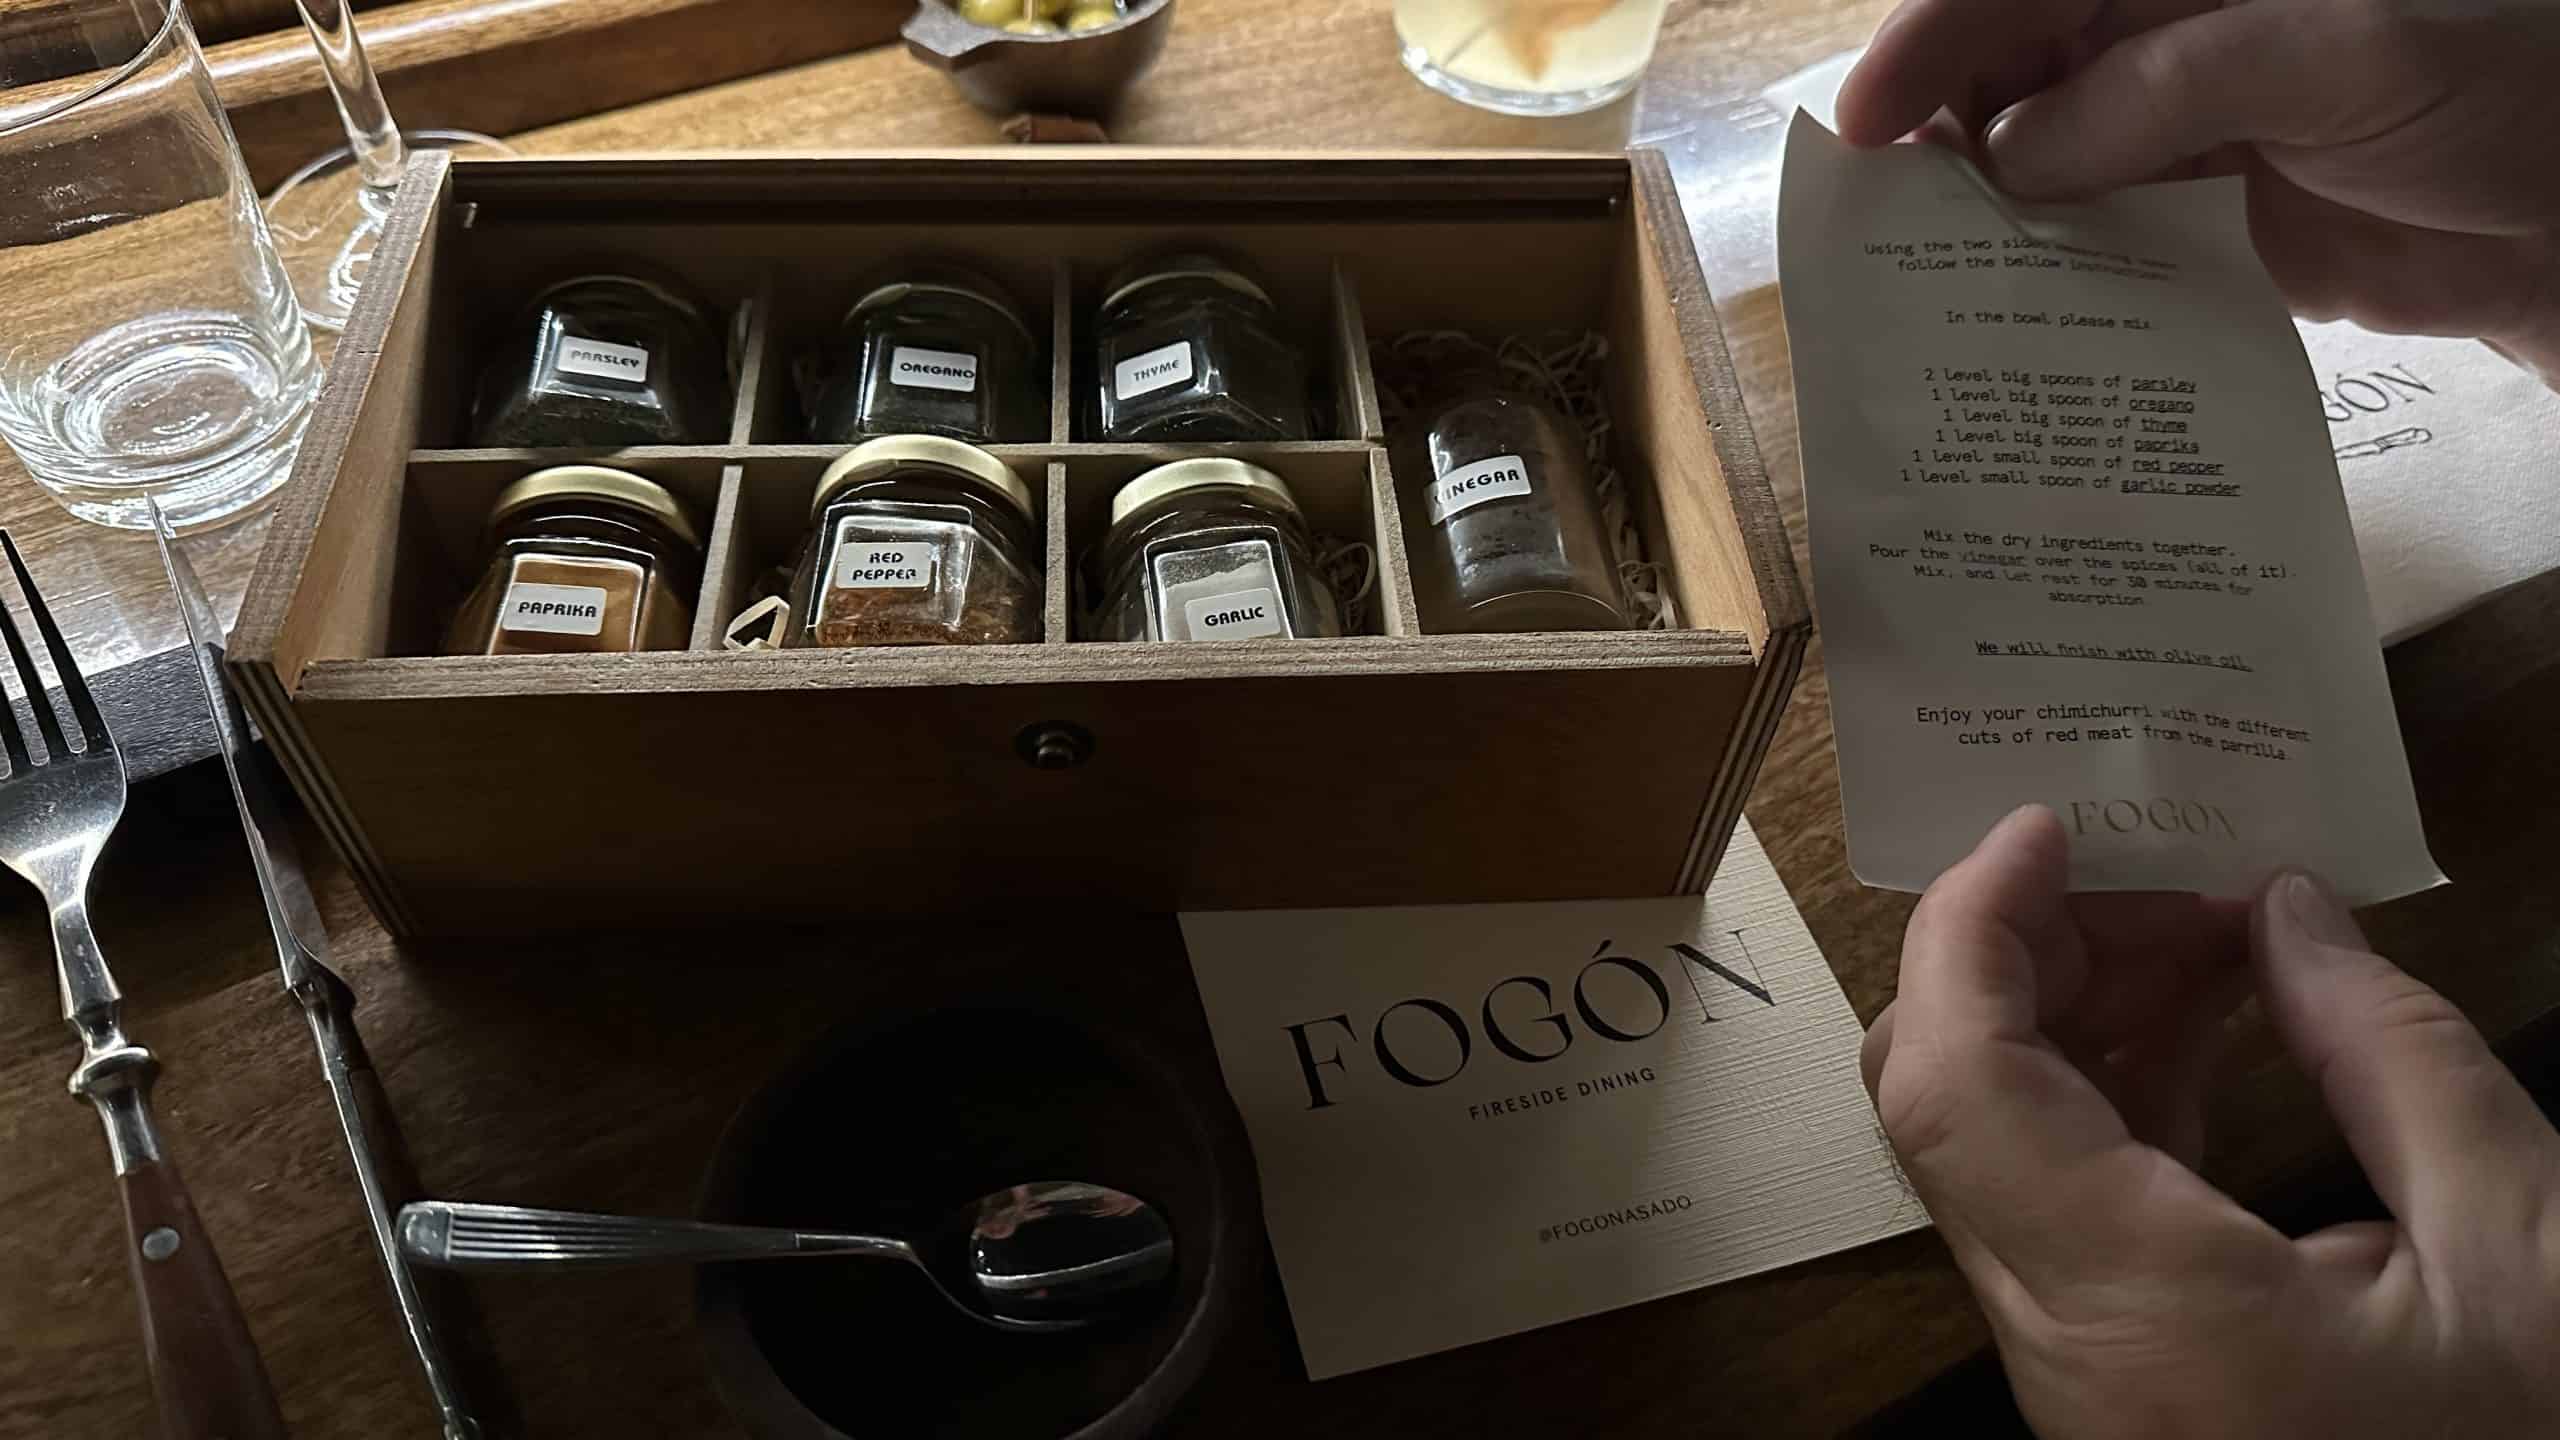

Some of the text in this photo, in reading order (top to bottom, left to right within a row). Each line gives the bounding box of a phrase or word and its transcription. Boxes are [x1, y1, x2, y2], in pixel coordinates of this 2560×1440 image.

[1864, 240, 1914, 257] Using
[1924, 240, 1953, 253] the
[1963, 239, 1992, 251] two
[1898, 256, 1957, 272] follow
[1965, 256, 1994, 269] the
[2003, 256, 2061, 270] bellow
[1945, 310, 1965, 325] In
[1976, 311, 2004, 324] the
[2012, 311, 2051, 325] bowl
[2059, 312, 2115, 330] please
[571, 350, 640, 368] PARSLEY
[900, 362, 975, 379] OREGANO
[1133, 359, 1180, 381] THYME
[1924, 367, 2197, 393] 2 level big spoons of parsley
[1931, 388, 2195, 414] 1 level big spoon of oregano
[1944, 408, 2188, 433] 1 level big spoon of thyme
[1936, 429, 2200, 454] 1 level big spoon of paprika
[1912, 449, 2225, 475] 1 level small spoon of red pepper
[1901, 468, 2241, 497] 1 level small spoon of garlic powder
[1924, 529, 2236, 558] Mix the dry ingredients together.
[869, 552, 904, 564] RED
[1869, 543, 1912, 559] Pour
[1920, 547, 1950, 561] the
[1960, 551, 2025, 566] vinegar
[2035, 556, 2073, 568] over
[2083, 556, 2112, 569] the
[2121, 559, 2177, 573] spices
[2187, 559, 2225, 576] (all
[2231, 562, 2249, 576] of
[852, 568, 917, 581] PEPPER
[1913, 565, 1953, 579] Mix,
[1966, 568, 1995, 580] and
[2003, 569, 2032, 583] let
[2041, 573, 2080, 585] rest
[2089, 572, 2118, 586] for
[518, 601, 597, 618] PAPRIKA
[1204, 606, 1265, 627] GARLIC
[1976, 640, 1999, 656] We
[2007, 640, 2048, 656] will
[2057, 641, 2107, 660] finish
[2116, 647, 2155, 663] with
[2162, 647, 2208, 665] olive
[1917, 703, 2312, 742] Enjoy your chimichurri with the different
[1958, 730, 2001, 744] cuts
[2012, 728, 2032, 743] of
[2045, 728, 2078, 742] red
[2087, 725, 2136, 741] meat
[2144, 724, 2183, 742] from
[2187, 731, 2213, 748] the
[1281, 929, 1776, 1111] FOGÓN
[1469, 1067, 1656, 1121] FIRESIDE DINING
